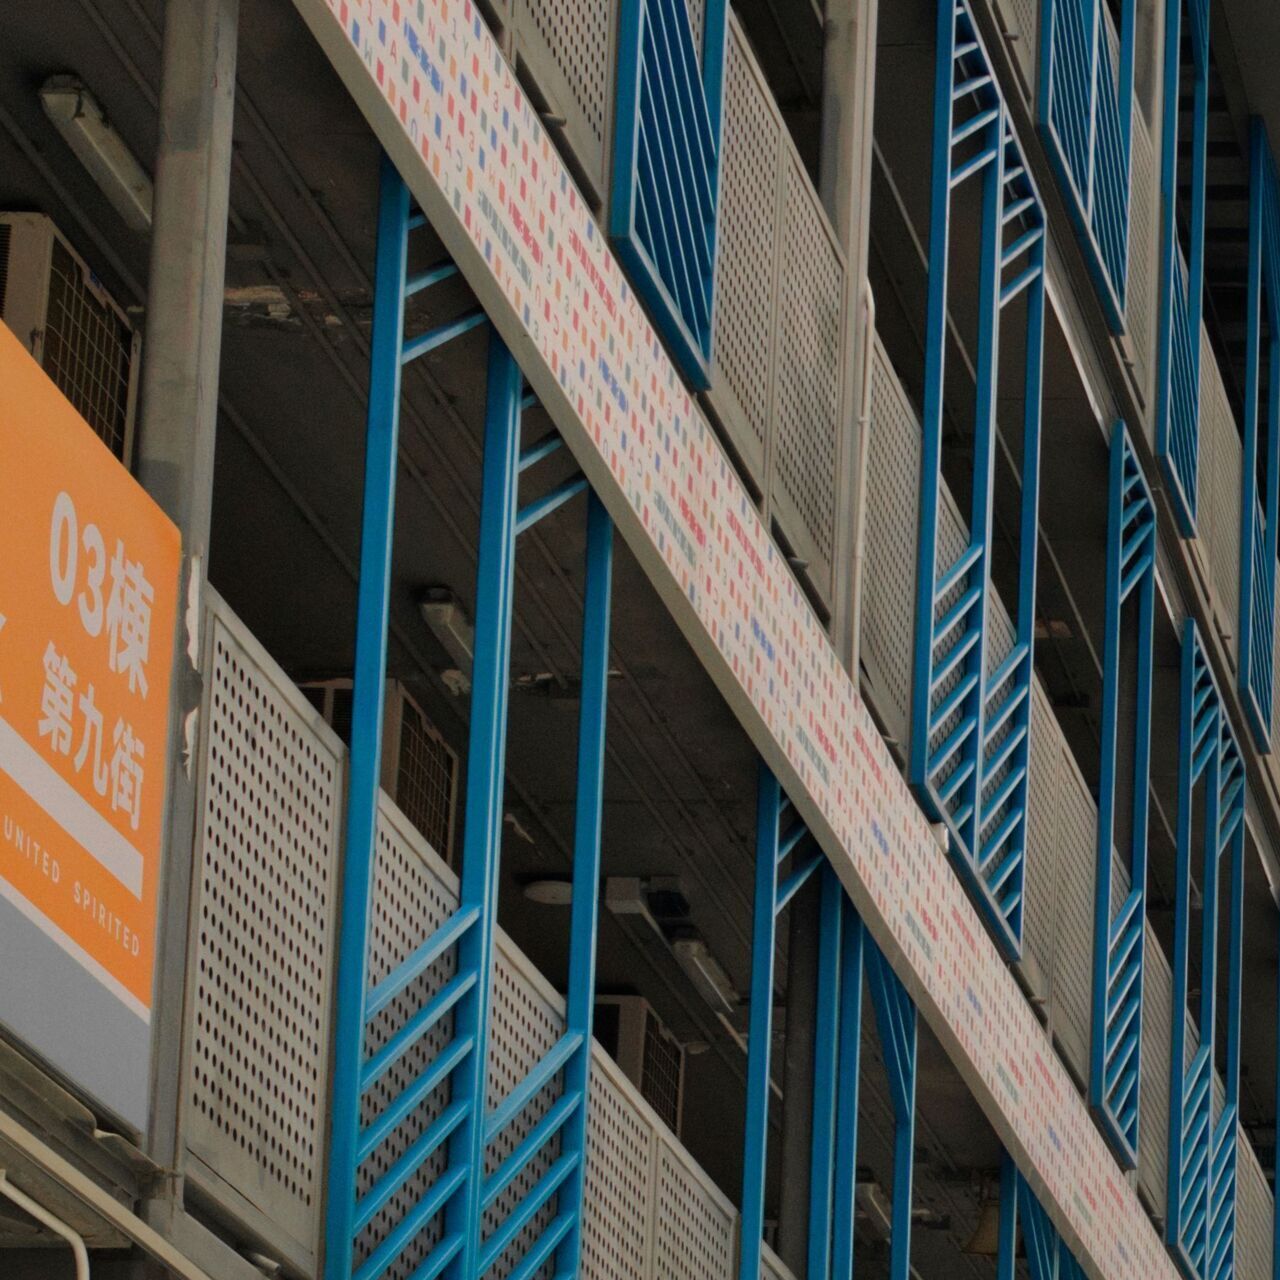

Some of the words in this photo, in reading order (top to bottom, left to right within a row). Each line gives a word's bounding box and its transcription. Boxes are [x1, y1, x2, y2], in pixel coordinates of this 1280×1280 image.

[50, 490, 154, 700] 03棟
[38, 639, 145, 831] 第九街
[4, 814, 60, 885] UNITED
[73, 880, 140, 957] SPIRITED
